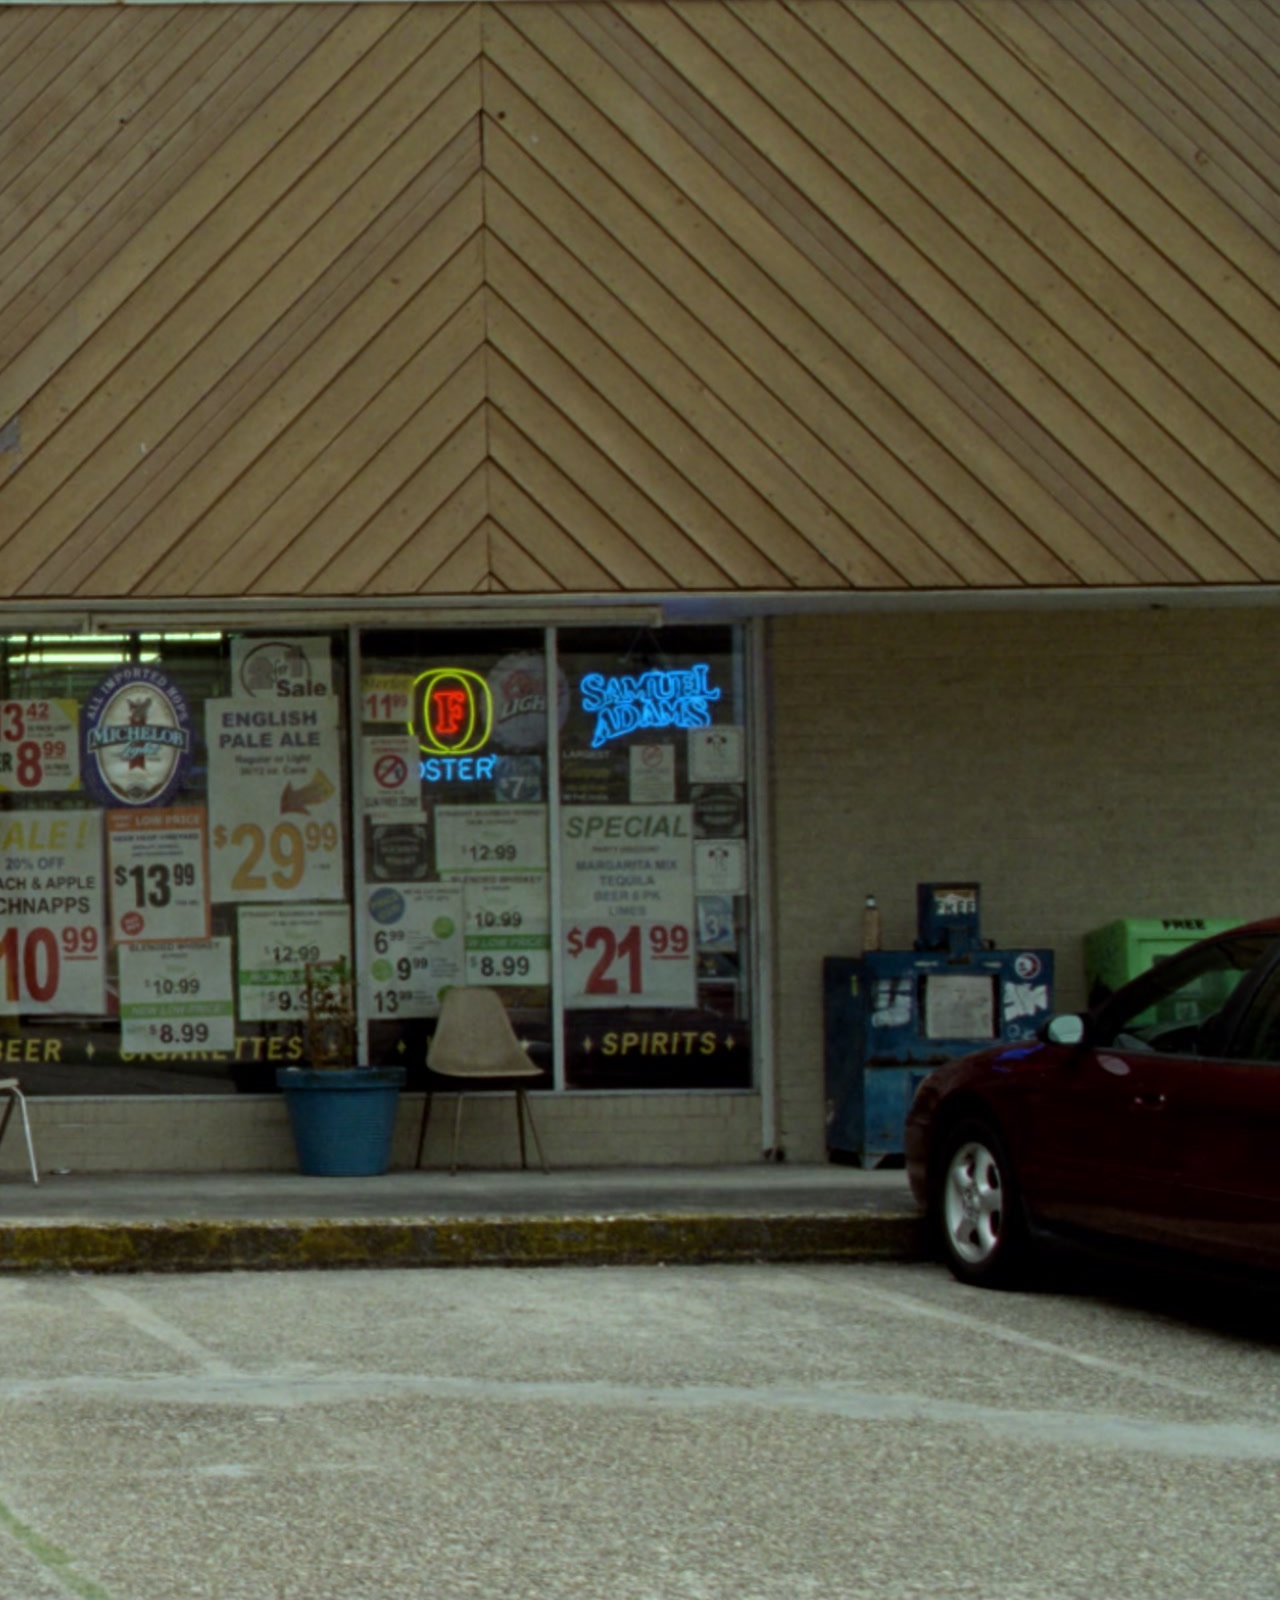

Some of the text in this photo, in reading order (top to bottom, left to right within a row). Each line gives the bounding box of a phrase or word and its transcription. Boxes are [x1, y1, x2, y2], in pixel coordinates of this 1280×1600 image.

[101, 669, 167, 697] IMPORTED
[276, 679, 327, 698] Sale
[580, 664, 721, 711] SAMUEL
[433, 689, 466, 735] F
[502, 695, 546, 717] LIGH
[222, 710, 318, 728] ENGLISH
[591, 698, 712, 749] ADAMS
[89, 727, 185, 747] MICHELOB
[219, 732, 321, 749] PALE ALE
[566, 815, 688, 839] SPECIAL
[5, 856, 67, 870] 20% OFF
[576, 859, 678, 872] MARGARITA MIX
[32, 876, 42, 890] &
[45, 875, 96, 890] APPLE
[599, 875, 656, 887] TEQUILA
[593, 890, 629, 902] BEER
[608, 905, 647, 917] LIMES
[1162, 919, 1206, 930] FREE
[601, 1031, 720, 1057] SPIRITS
